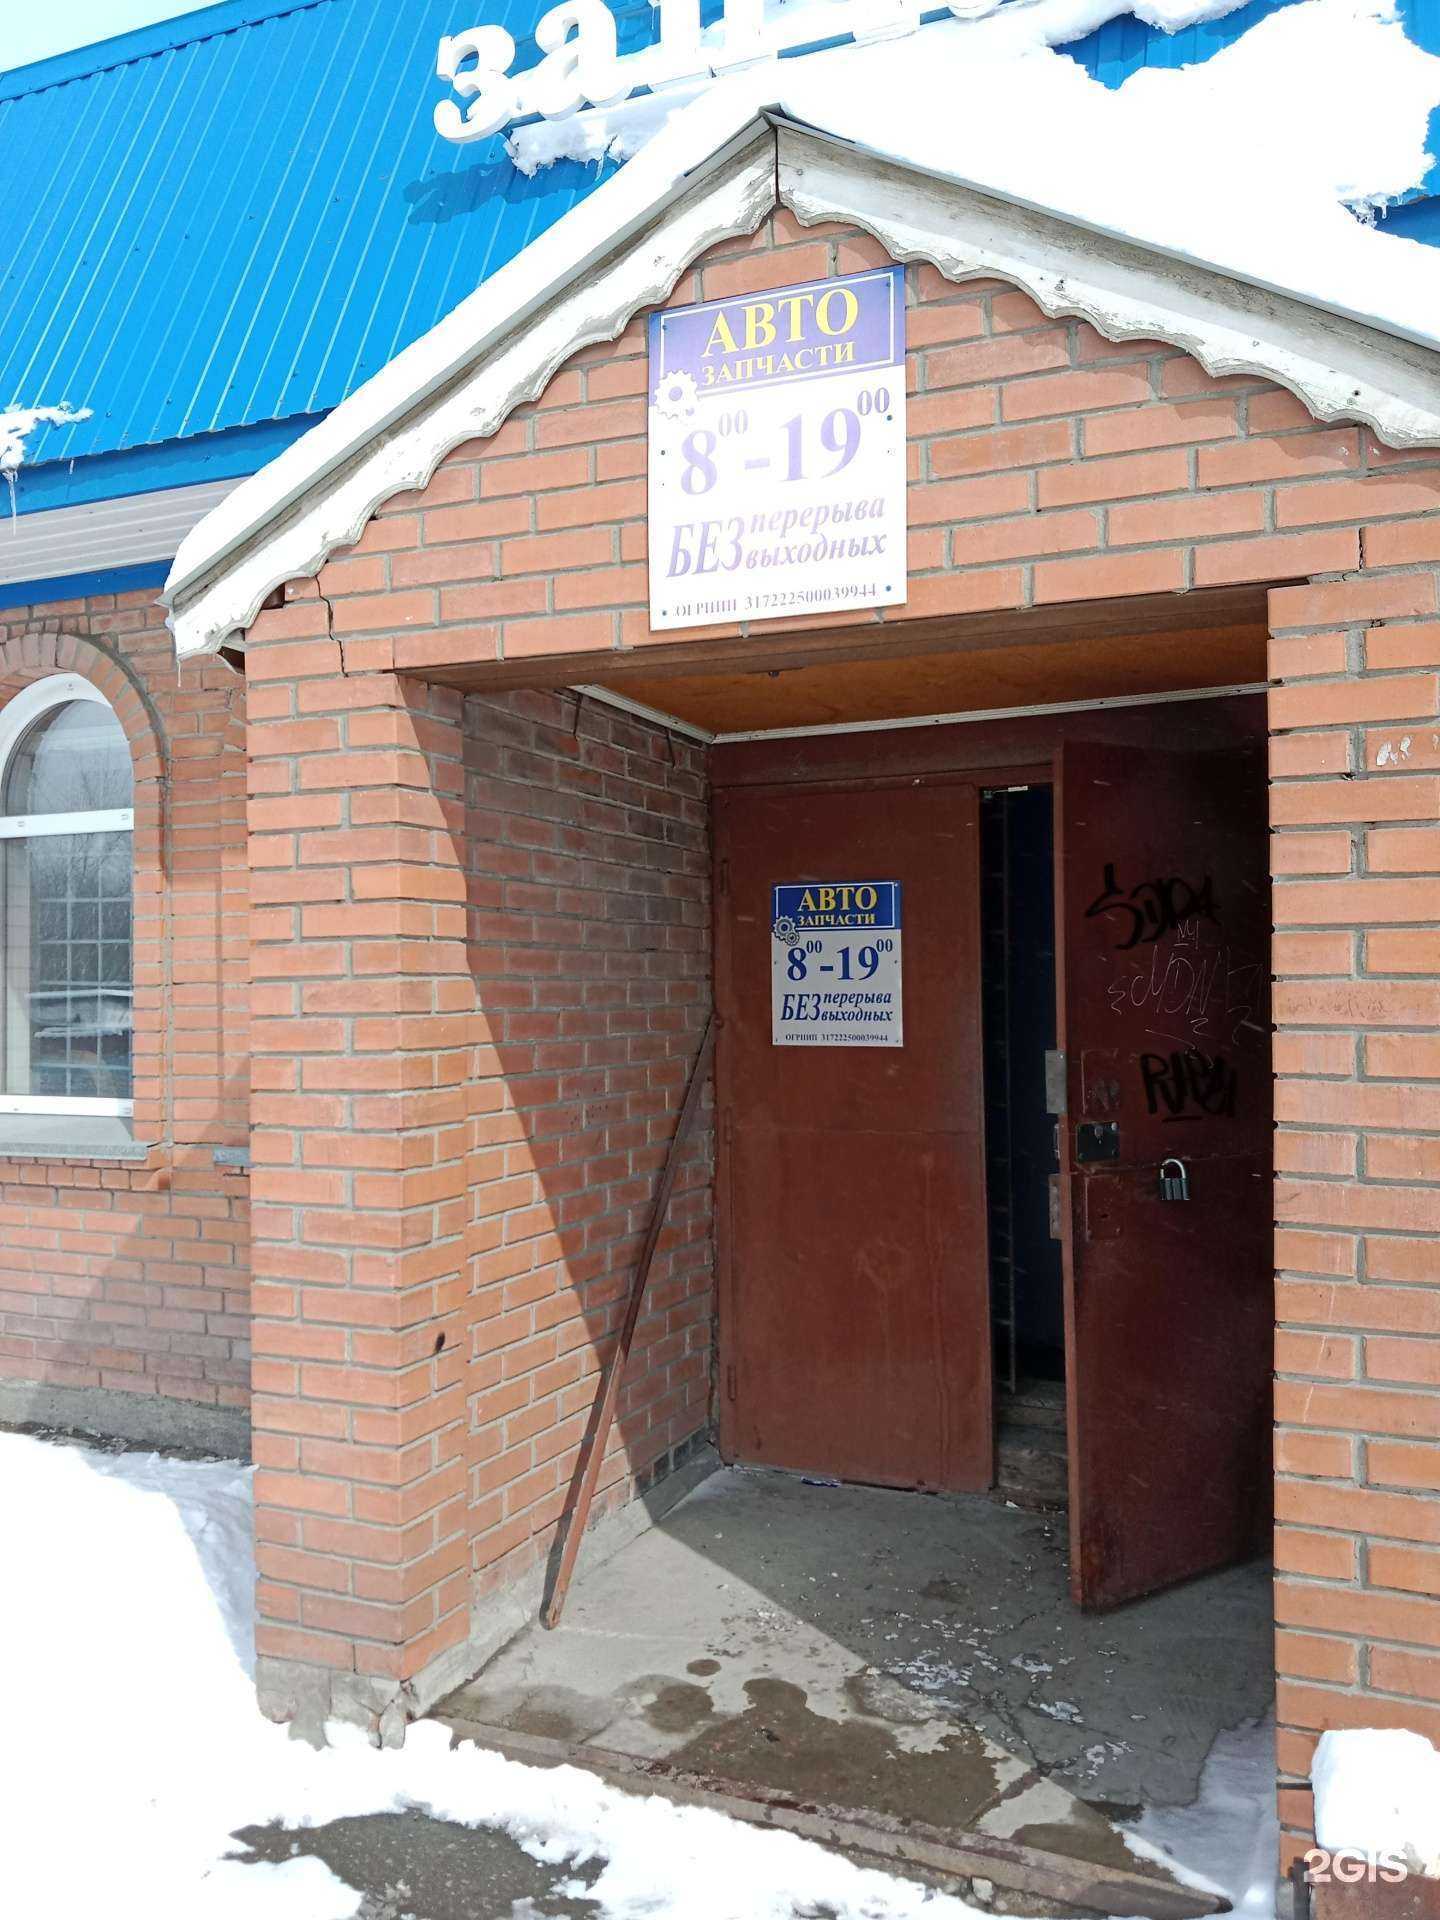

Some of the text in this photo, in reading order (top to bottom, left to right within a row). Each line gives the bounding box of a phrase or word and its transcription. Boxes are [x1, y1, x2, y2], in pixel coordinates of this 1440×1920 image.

[700, 287, 859, 358] АВТО
[701, 341, 856, 386] ЗАПЧАСТИ
[665, 496, 886, 578] БЕЗ перерыва
[745, 532, 888, 570] выходных
[797, 886, 878, 912] АВТО
[797, 913, 876, 927] ЗАПЧАСТИ
[780, 992, 892, 1021] БЕЗ перерыва
[821, 1006, 893, 1022] выходных
[785, 1033, 818, 1042] ОГРНИП
